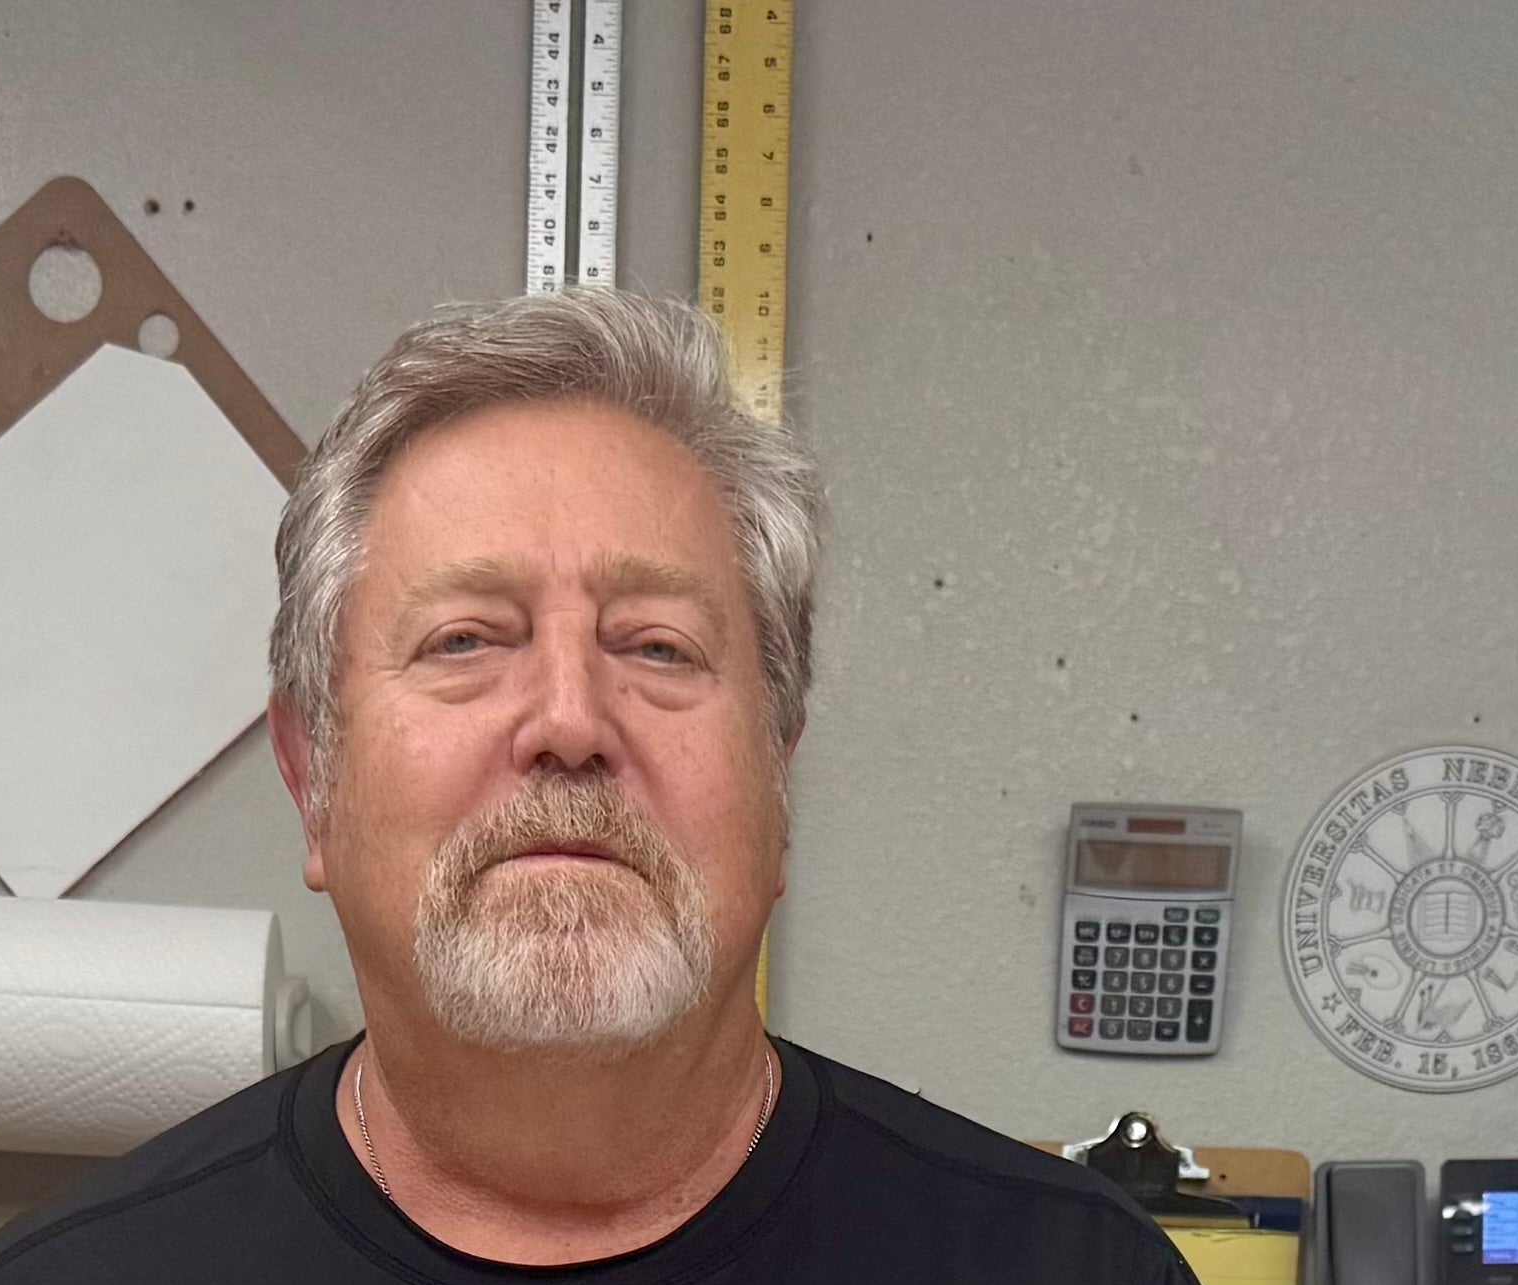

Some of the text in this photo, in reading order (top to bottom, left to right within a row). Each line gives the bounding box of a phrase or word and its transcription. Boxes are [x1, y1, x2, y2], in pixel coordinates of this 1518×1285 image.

[767, 10, 778, 20] 4
[548, 32, 560, 60] 44
[765, 57, 777, 68] 5
[547, 79, 559, 107] 43
[763, 104, 775, 114] 6
[546, 126, 559, 154] 42
[587, 34, 605, 278] 4 5 6 7 8 9
[763, 152, 774, 161] 7
[545, 173, 557, 201] 41
[761, 197, 773, 207] 8
[544, 218, 556, 246] 40
[757, 291, 769, 316] 10
[757, 338, 768, 361] 11
[1295, 767, 1410, 978] UNIVERSITAS
[1335, 1013, 1402, 1069] FEB.
